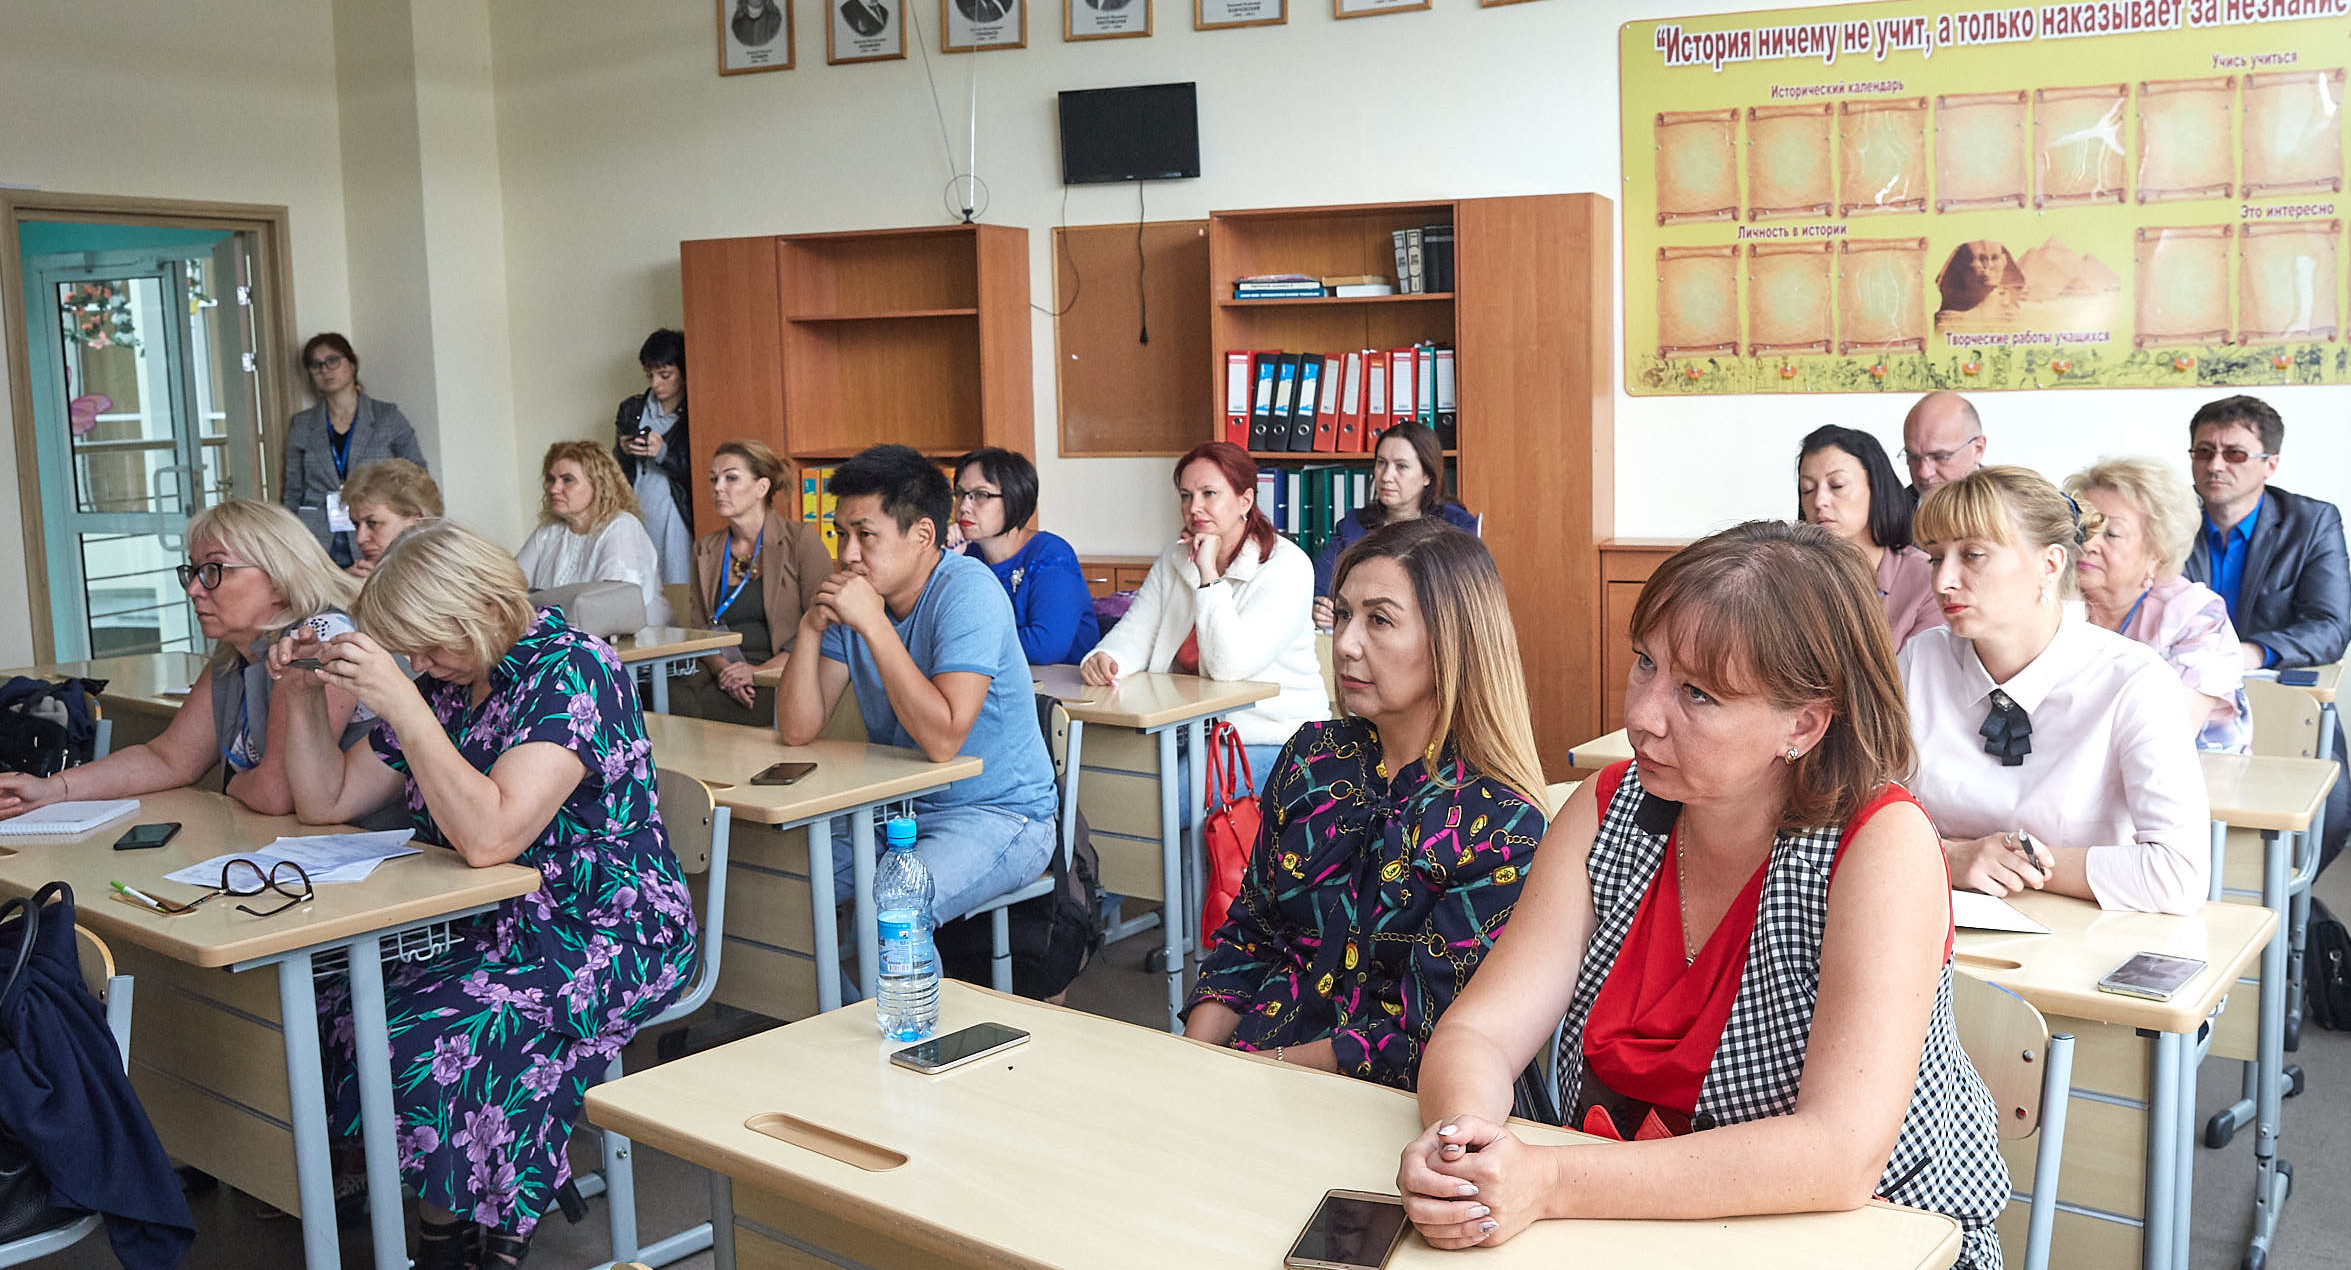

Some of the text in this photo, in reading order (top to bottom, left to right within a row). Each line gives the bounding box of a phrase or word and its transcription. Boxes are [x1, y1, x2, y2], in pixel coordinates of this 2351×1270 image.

[1759, 25, 1837, 61] ничему
[1845, 22, 1869, 50] не
[1877, 18, 1930, 58] учит,
[1939, 16, 1950, 43] а
[1958, 10, 2033, 41] только
[2043, 0, 2181, 35] наказывает
[2191, 0, 2217, 23] за
[2212, 52, 2297, 69] Учись учиться
[1771, 80, 1904, 99] Исторический календарь
[2240, 204, 2334, 218] Это интересно
[1738, 225, 1847, 238] Личность в истории
[1946, 331, 2110, 348] Творческие работы учащихся
